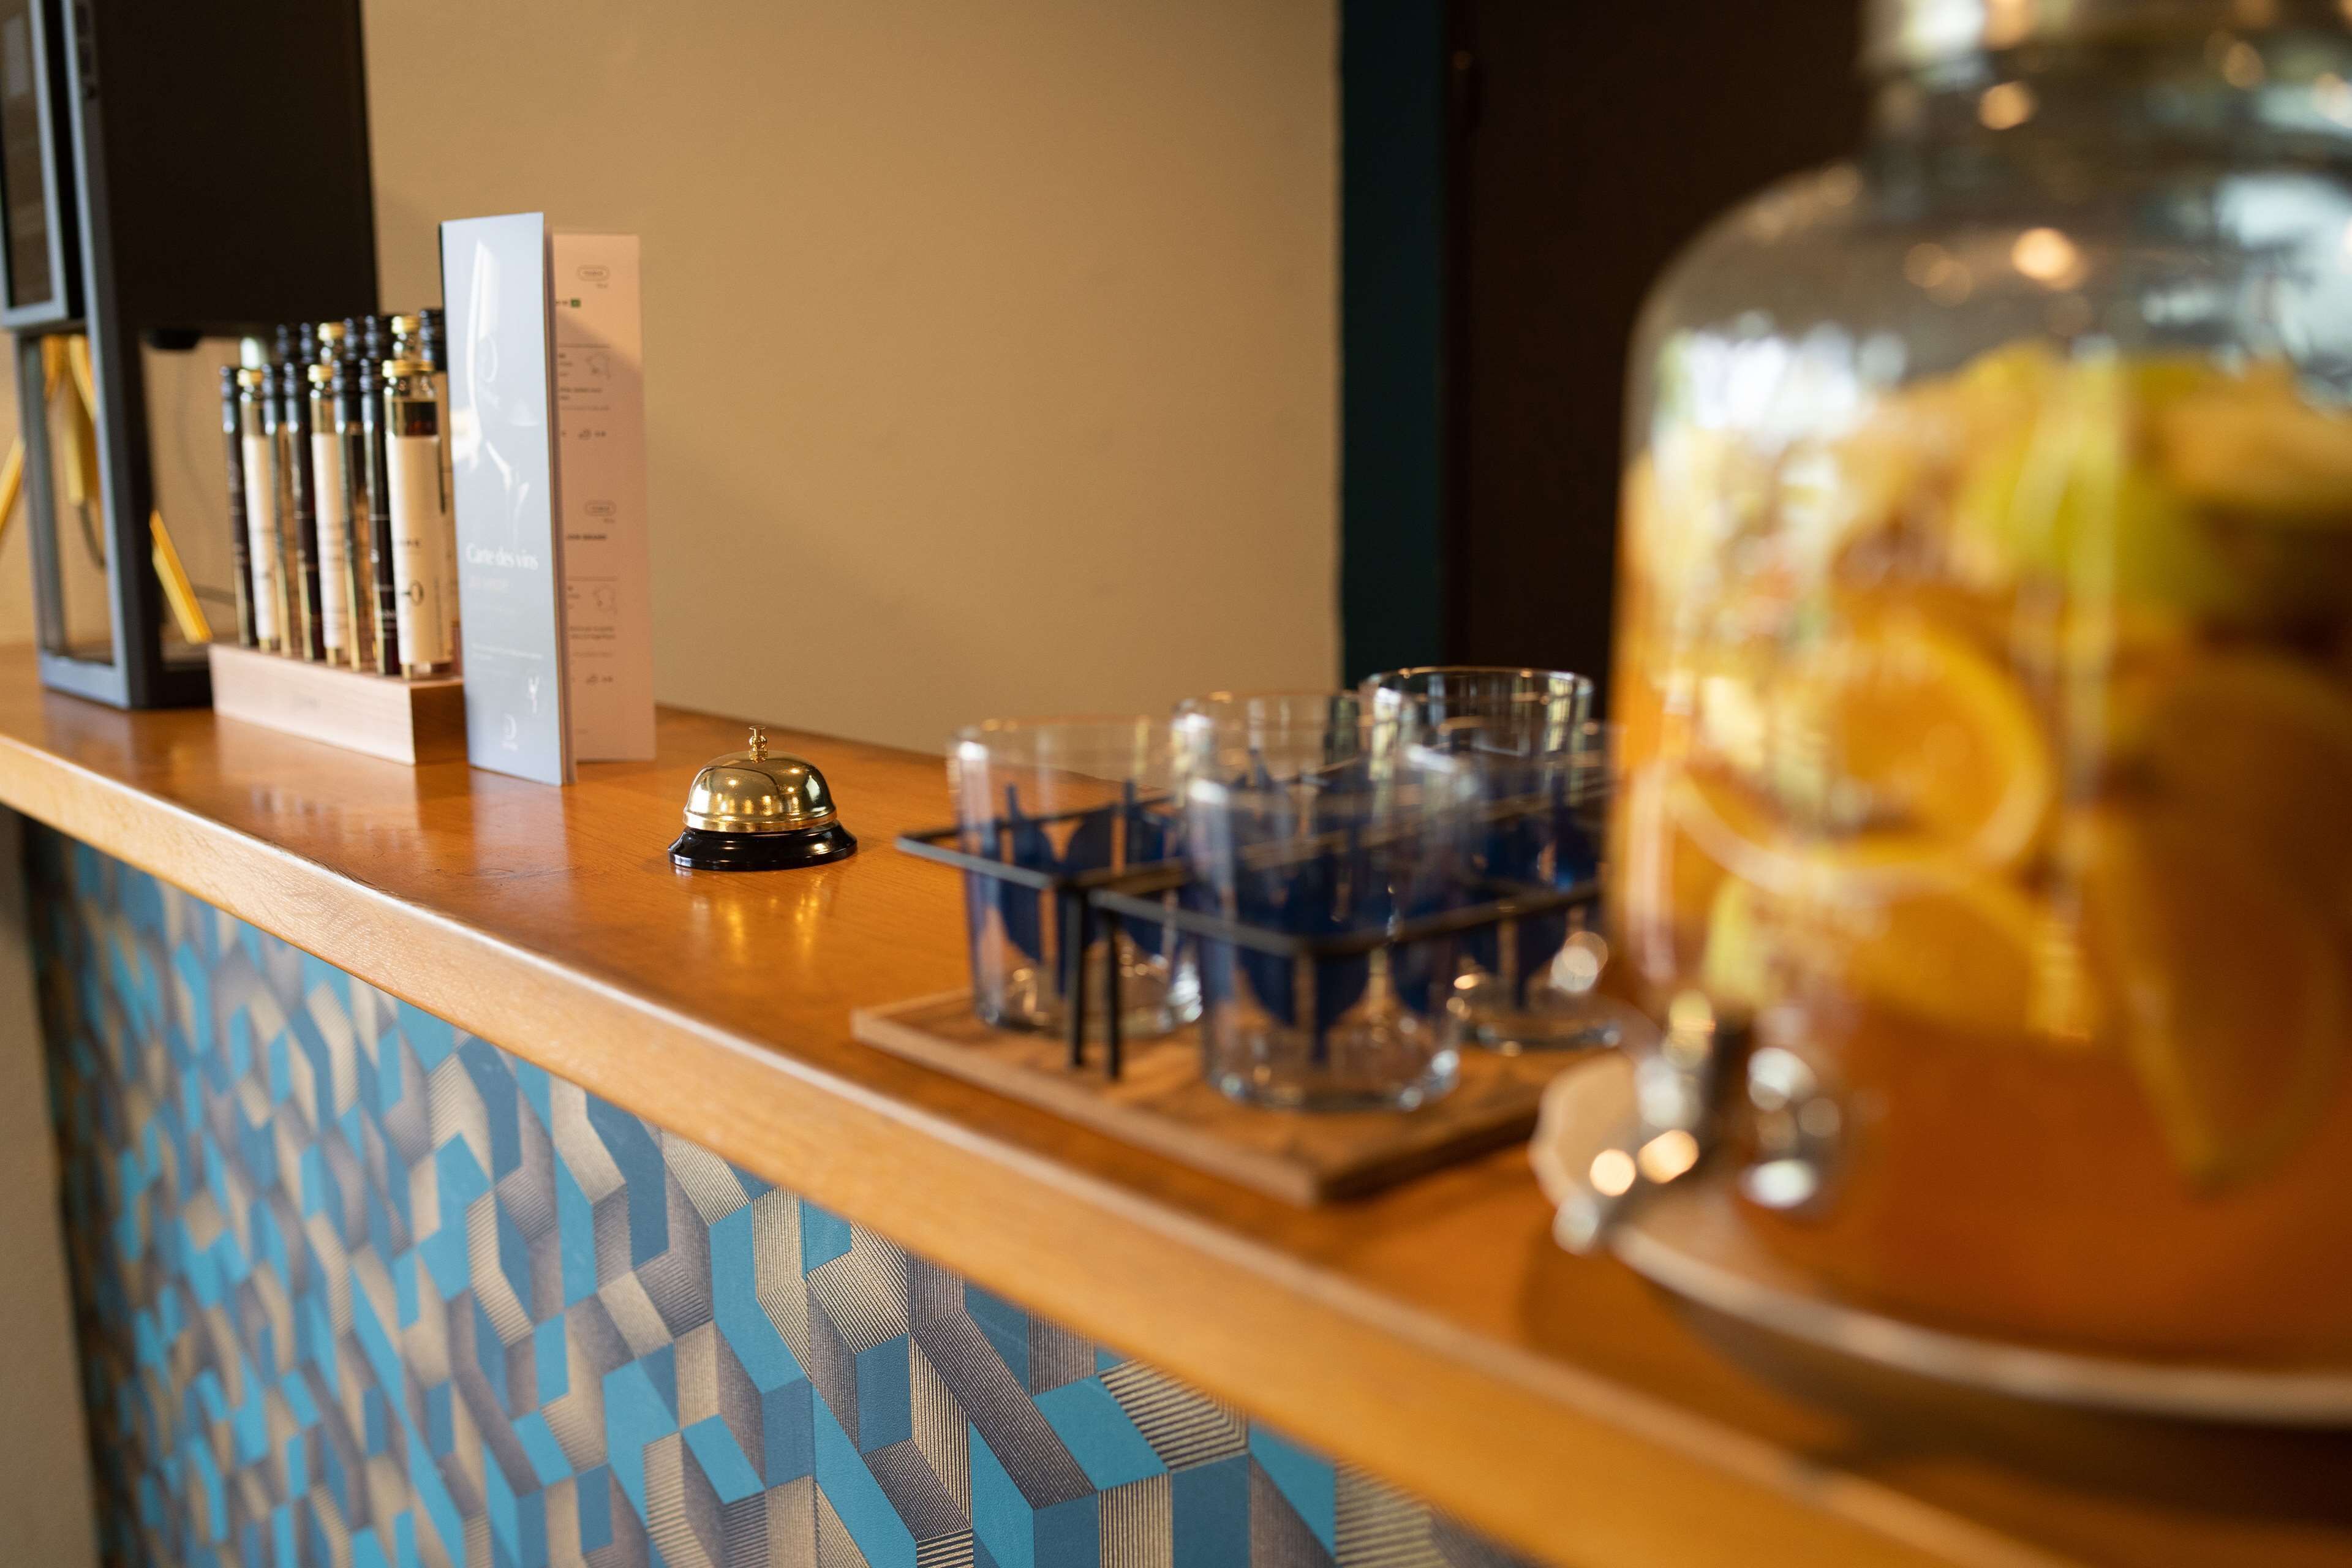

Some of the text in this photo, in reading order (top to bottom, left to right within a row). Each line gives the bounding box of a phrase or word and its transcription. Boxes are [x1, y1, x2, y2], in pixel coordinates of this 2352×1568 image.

[466, 542, 539, 570] Carte des vins
